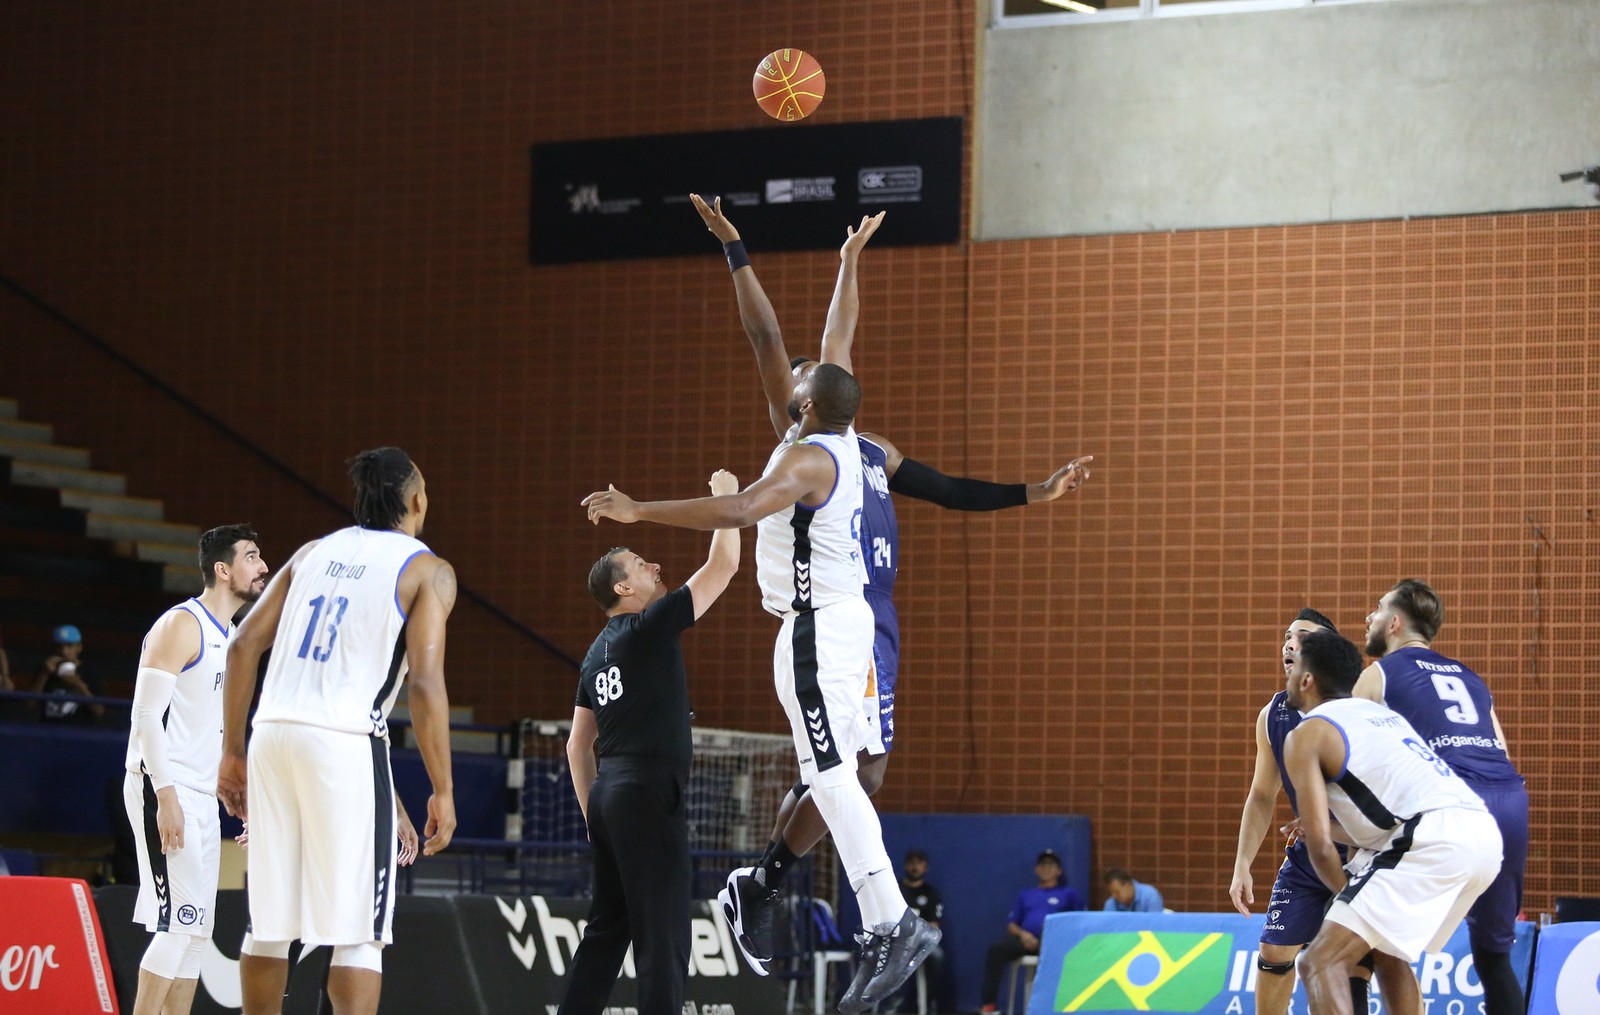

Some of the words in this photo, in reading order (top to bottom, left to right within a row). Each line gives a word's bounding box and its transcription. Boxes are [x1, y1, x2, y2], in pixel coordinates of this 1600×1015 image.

[325, 560, 366, 580] TOLDO
[873, 536, 892, 568] 24
[297, 594, 349, 663] 13
[595, 666, 623, 706] 98
[1431, 673, 1479, 725] 9
[1428, 734, 1493, 751] Höganäs
